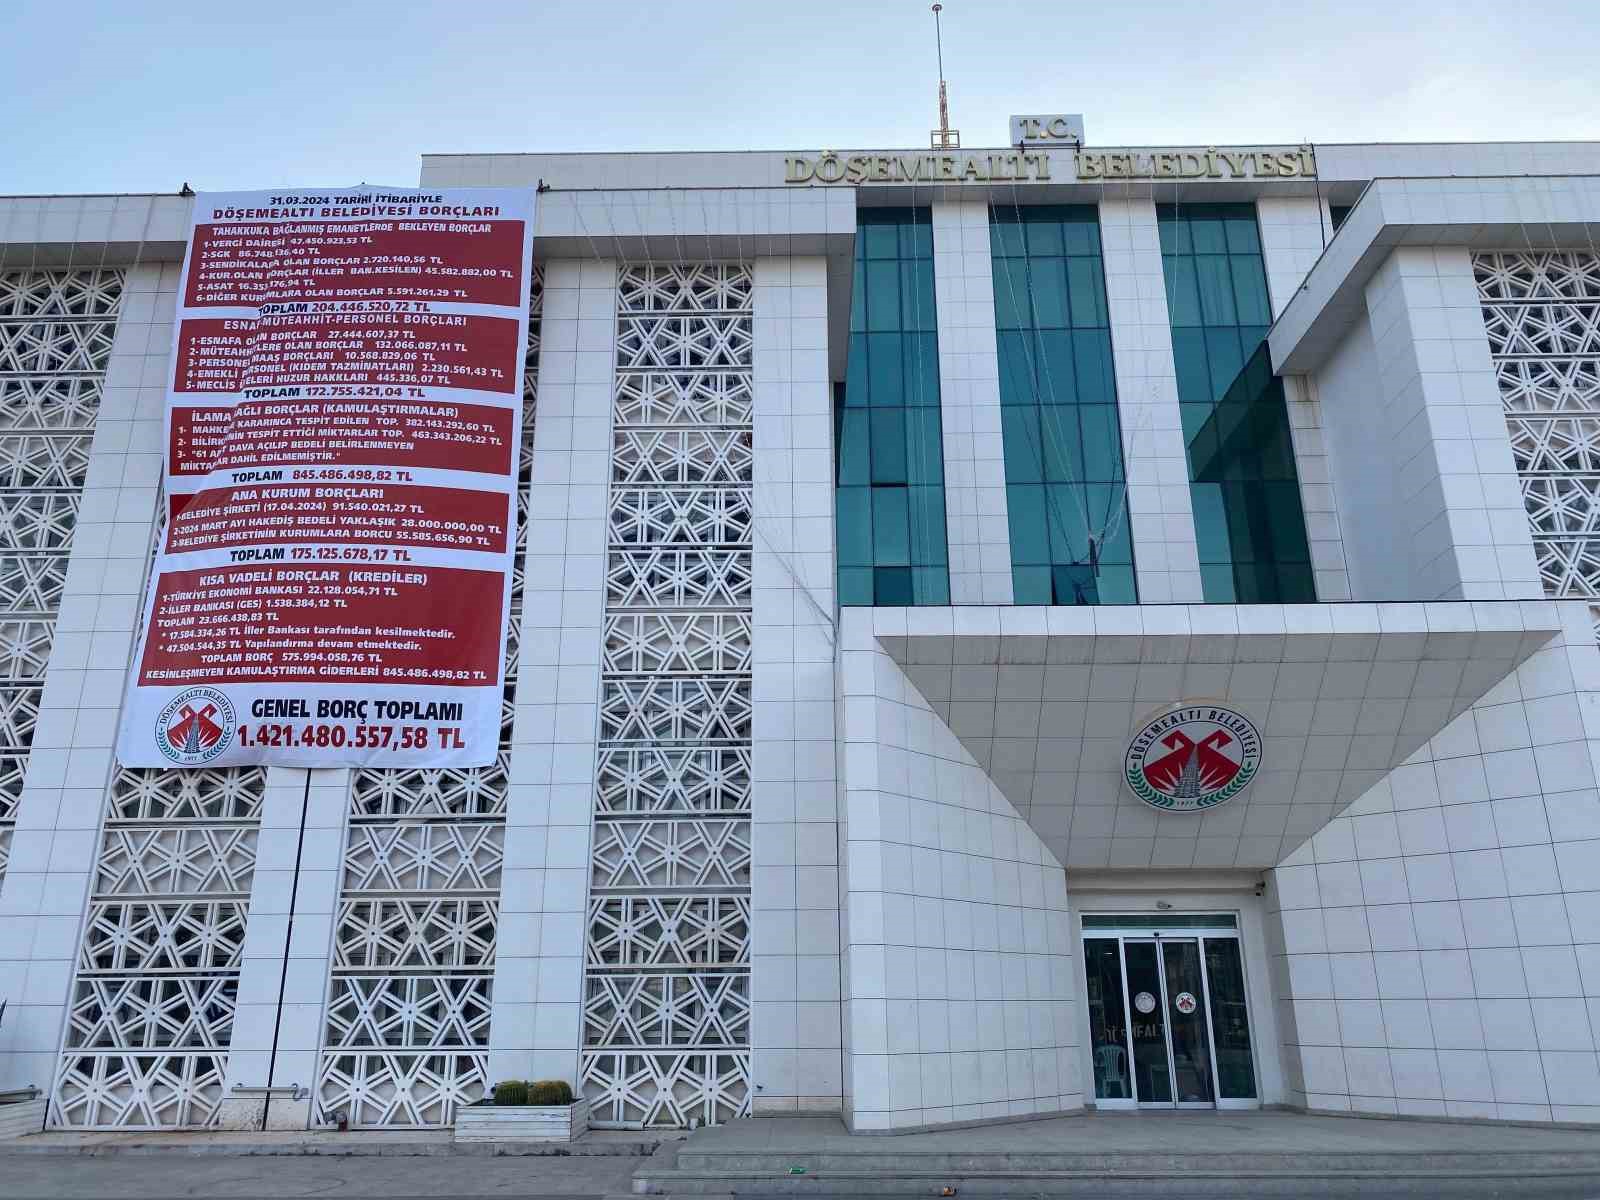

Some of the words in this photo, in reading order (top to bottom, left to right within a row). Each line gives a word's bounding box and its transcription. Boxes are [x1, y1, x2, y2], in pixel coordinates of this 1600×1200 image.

[1020, 118, 1077, 140] T.C.
[785, 150, 1051, 185] DÖŞEMEALTI
[1074, 144, 1316, 180] BELEDİYESİ
[270, 196, 330, 206] 31.03.2024
[334, 194, 372, 205] TARİHİ
[376, 193, 443, 204] İTİBARİYLE
[213, 206, 314, 221] DÖŞEMEALTI
[320, 204, 412, 217] BELEDİYESİ
[418, 206, 500, 219] BORÇLARI
[212, 226, 270, 236] TAHAKKUKA
[272, 223, 325, 237] BAĞLANMIŞ
[326, 222, 394, 234] EMANETLERDE
[398, 222, 446, 232] BEKLEYEN
[448, 222, 492, 235] BORÇLAR
[204, 238, 243, 248] 1-VERGİ
[202, 250, 231, 259] 2-SGK
[308, 247, 321, 255] TL
[283, 258, 310, 266] OLAN
[312, 257, 360, 268] BORÇLAR
[362, 256, 426, 264] 2.720.140,56
[430, 256, 444, 264] TL
[312, 268, 344, 277] (İLLER
[424, 268, 497, 278] 45.582.882,00
[500, 269, 513, 278] TL
[198, 282, 234, 291] 5-ASAT
[196, 291, 238, 302] 6-DİĞER
[304, 289, 334, 298] OLAN
[336, 288, 384, 298] BORÇLAR
[386, 288, 450, 298] 5.591.261,29
[454, 289, 468, 298] TL
[312, 301, 408, 313] 204.446.520,72
[415, 302, 431, 313] TL
[404, 314, 467, 327] BORÇLARI
[270, 330, 317, 342] BORÇLAR
[328, 330, 399, 340] 27.444.607,37
[402, 330, 416, 340] TL
[284, 341, 312, 350] OLAN
[316, 340, 363, 352] BORÇLAR
[375, 340, 451, 352] 132.066.087,11
[454, 343, 468, 352] TL
[283, 350, 334, 362] BORÇLARI
[345, 350, 418, 362] 10.568.829,06
[422, 352, 436, 362] TL
[288, 362, 327, 372] (KIDEM
[331, 360, 414, 372] TAZMİNATLARI)
[422, 364, 488, 378] 2.230.561,43
[490, 369, 504, 378] TL
[276, 374, 310, 384] HUZUR
[314, 372, 368, 383] HAKKLARI
[376, 374, 434, 384] 445.336,07
[437, 375, 451, 384] TL
[242, 386, 300, 399] TOPLAM
[305, 386, 402, 398] 172.755.421,04
[408, 387, 426, 398] TL
[192, 409, 232, 422] İLAMA
[264, 404, 320, 417] BORÇLAR
[322, 402, 459, 418] (KAMULAŞTIRMALAR)
[238, 416, 292, 429] KARARINCA
[294, 416, 330, 426] TESPİT
[333, 416, 370, 426] EDİLEN
[376, 417, 400, 426] TOP.
[405, 418, 480, 432] 382.143.292,60
[482, 424, 496, 434] TL
[247, 428, 281, 439] TESPİT
[282, 427, 315, 438] ETTİĞİ
[318, 427, 378, 438] MİKTARLAR
[382, 428, 405, 438] TOP.
[411, 430, 486, 444] 463.343.206,22
[490, 437, 503, 446] TL
[230, 442, 254, 452] DAVA
[256, 441, 289, 453] AÇILIP
[290, 438, 326, 450] BEDELİ
[328, 439, 415, 451] BELİRLENMEYEN
[230, 452, 258, 464] DAHİL
[232, 470, 284, 483] TOPLAM
[292, 470, 392, 482] 845.486.498,82
[396, 470, 413, 482] TL
[232, 490, 258, 502] ANA
[261, 488, 311, 499] KURUM
[314, 488, 384, 500] BORÇLARI
[224, 503, 261, 516] ŞİRKETİ
[332, 502, 406, 514] 91.540.021,27
[409, 504, 425, 514] TL
[201, 520, 228, 532] MART
[230, 518, 246, 528] AYI
[248, 516, 294, 528] HAKEDİŞ
[298, 516, 336, 526] BEDELİ
[339, 516, 396, 528] YAKLAŞIK
[401, 518, 484, 532] 28.000.000,00
[488, 524, 502, 534] TL
[220, 530, 277, 542] ŞİRKETİNİN
[279, 528, 350, 538] KURUMLARA
[354, 530, 392, 540] BORCU
[396, 530, 473, 544] 55.585.656,90
[476, 536, 490, 546] TL
[230, 548, 286, 562] TOPLAM
[290, 547, 388, 562] 175.125.678,17
[393, 549, 411, 562] TL
[200, 574, 225, 587] KISA
[228, 568, 273, 584] VADELİ
[276, 570, 340, 584] BORÇLAR
[348, 570, 428, 588] (KREDİLER)
[208, 584, 252, 599] EKONOMİ
[254, 586, 303, 596] BANKASI
[307, 586, 380, 597] 22.128.054,71
[384, 587, 398, 597] TL
[194, 602, 234, 613] BANKASI
[236, 598, 262, 611] (GES)
[266, 598, 329, 610] 1.538.384,12
[334, 599, 348, 608] TL
[158, 616, 195, 628] TOPLAM
[198, 612, 262, 625] 23.666.438,83
[266, 612, 280, 622] TL
[230, 626, 241, 636] TL
[244, 624, 264, 635] İller
[268, 624, 311, 635] Bankası
[314, 624, 372, 636] tarafından
[375, 626, 456, 640] kesilmektedir.
[230, 640, 242, 649] TL
[244, 638, 314, 650] Yapılandırma
[317, 638, 354, 648] devam
[356, 639, 422, 651] etmektedir.
[201, 652, 242, 664] TOPLAM
[244, 652, 274, 664] BORÇ
[282, 652, 365, 663] 575.994.058,76
[368, 653, 382, 663] TL
[146, 666, 224, 680] KESİNLEŞMEYEN
[226, 666, 316, 678] KAMULAŞTIRMA
[320, 664, 380, 676] GİDERLERİ
[382, 667, 470, 680] 845.486.498,82
[472, 670, 487, 680] TL
[252, 699, 311, 719] GENEL
[317, 700, 368, 725] BORÇ
[374, 700, 463, 721] TOPLAMI
[238, 724, 428, 752] 1.421.480.557,58
[438, 728, 466, 749] TL
